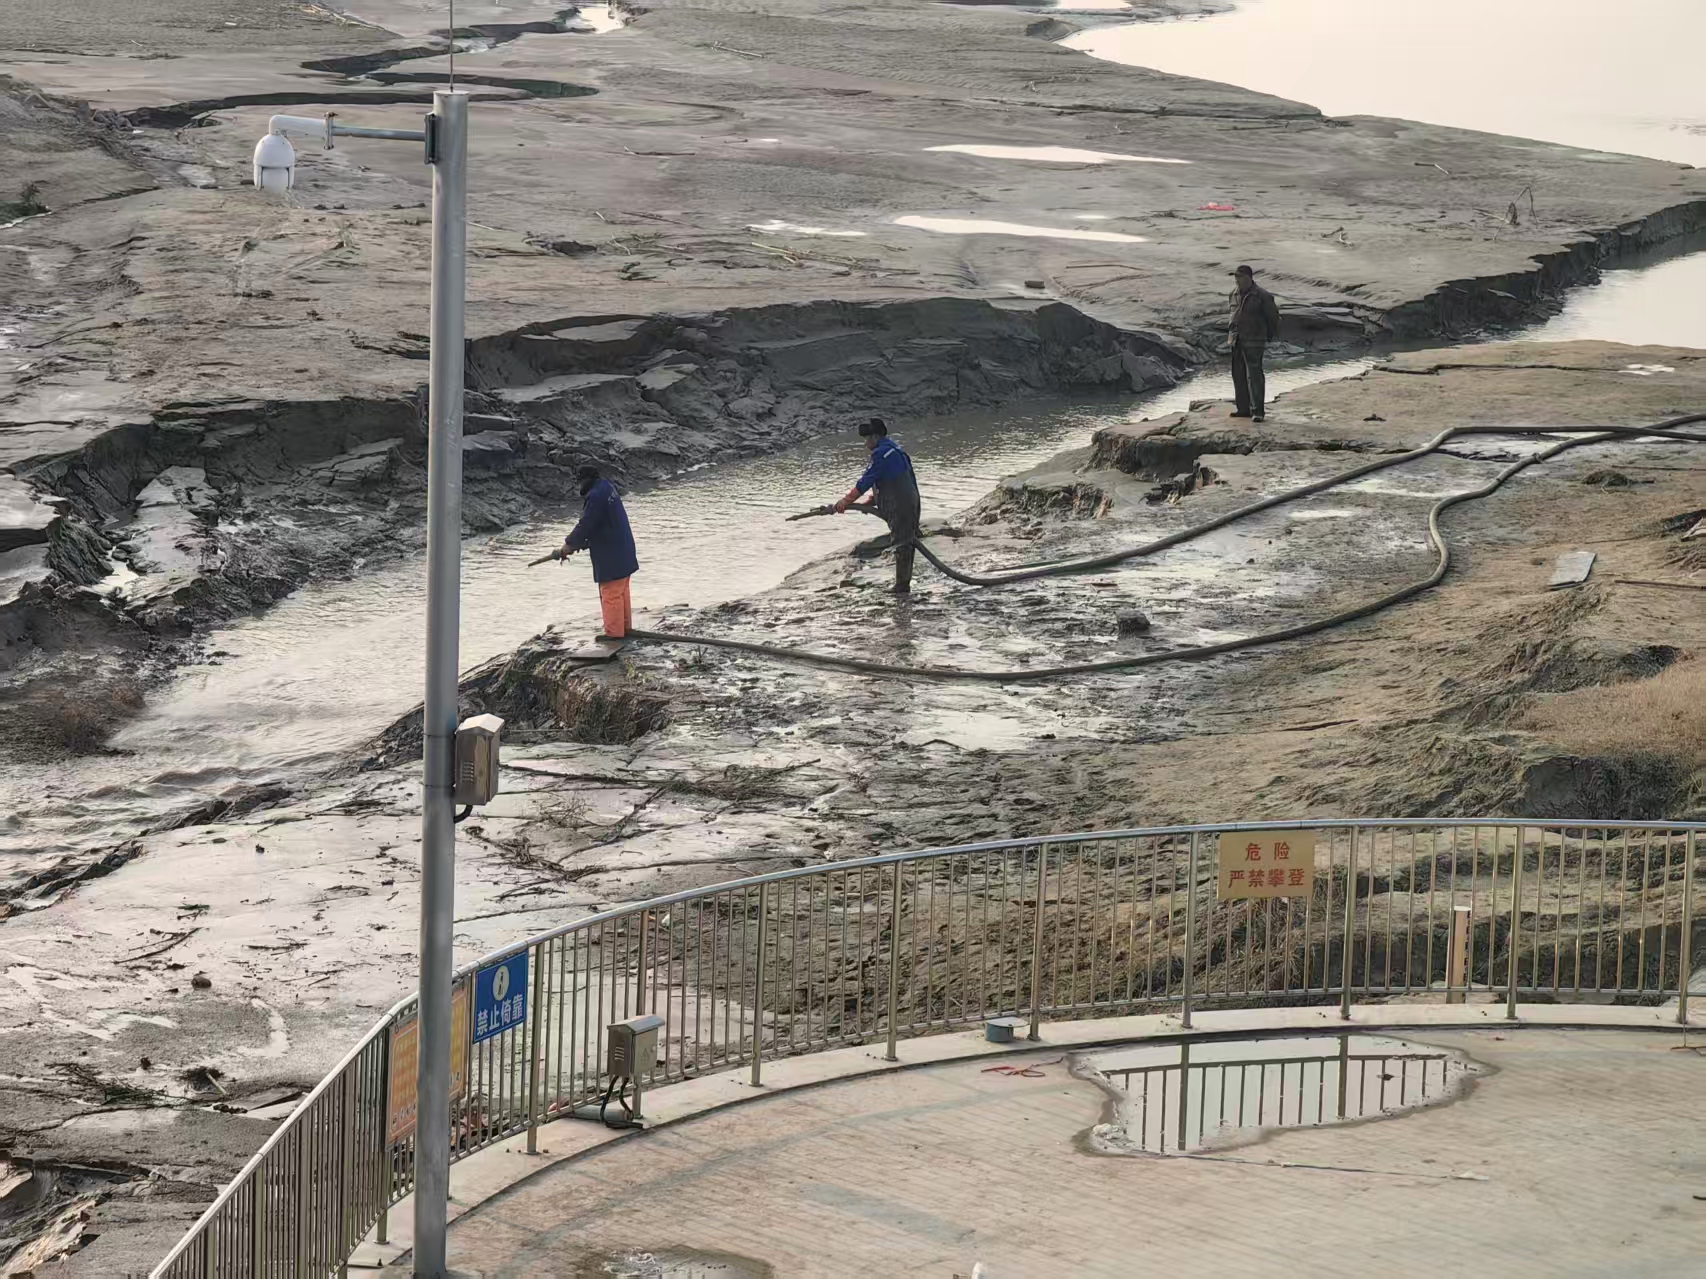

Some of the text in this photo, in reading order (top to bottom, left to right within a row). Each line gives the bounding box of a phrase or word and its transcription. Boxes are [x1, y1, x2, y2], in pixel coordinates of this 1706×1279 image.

[1245, 842, 1290, 861] 危险
[1228, 868, 1305, 888] 严禁攀登
[477, 994, 523, 1036] 禁止倚靠
